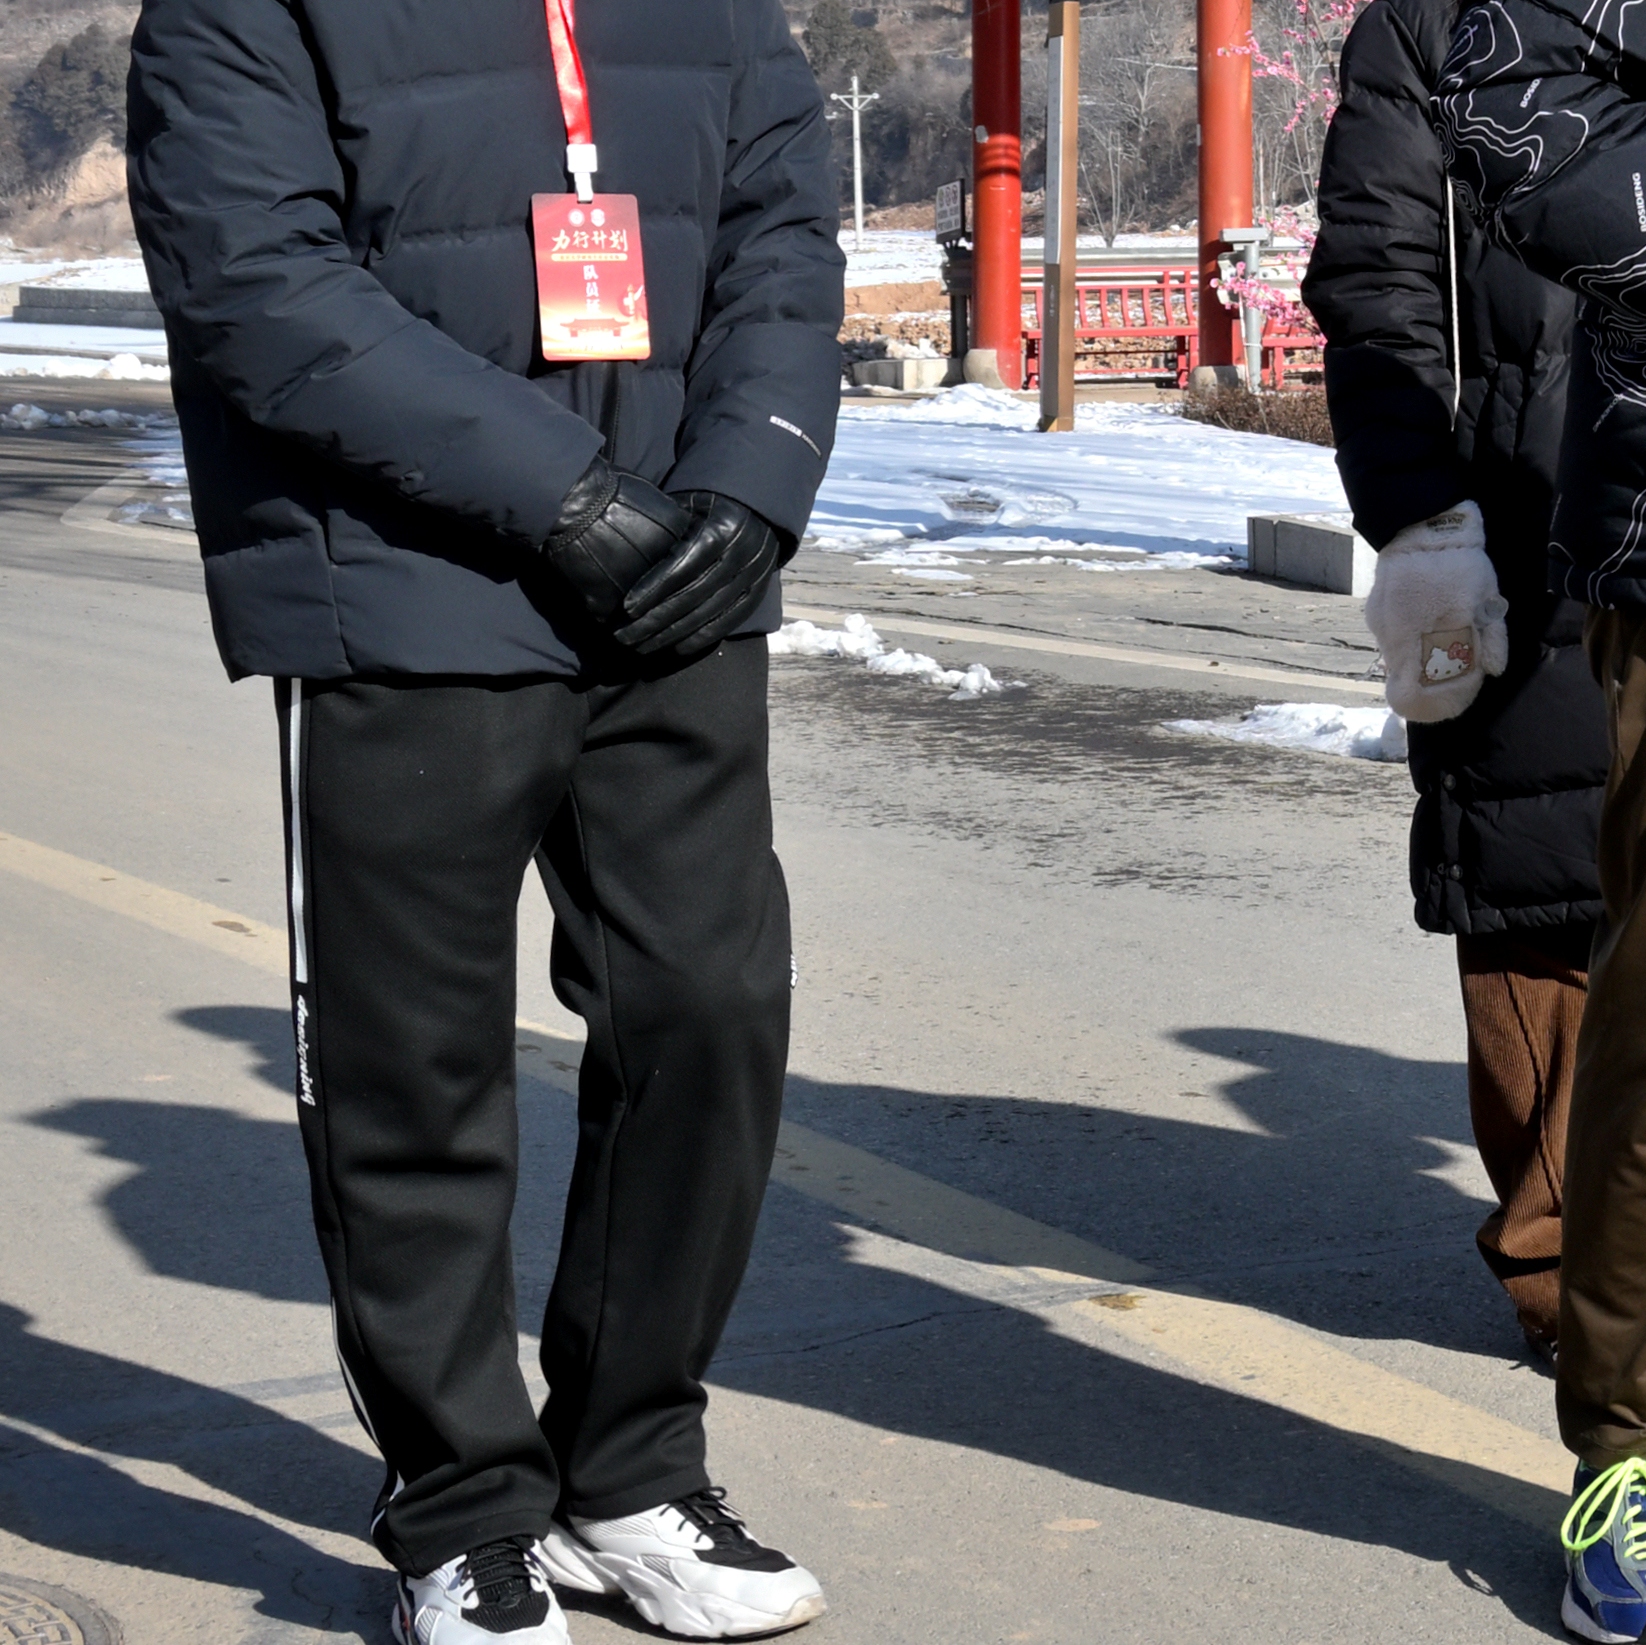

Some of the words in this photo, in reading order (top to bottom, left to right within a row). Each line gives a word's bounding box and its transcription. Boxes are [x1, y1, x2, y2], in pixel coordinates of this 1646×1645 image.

[551, 229, 629, 252] 力行计划
[583, 264, 601, 314] 队员证
